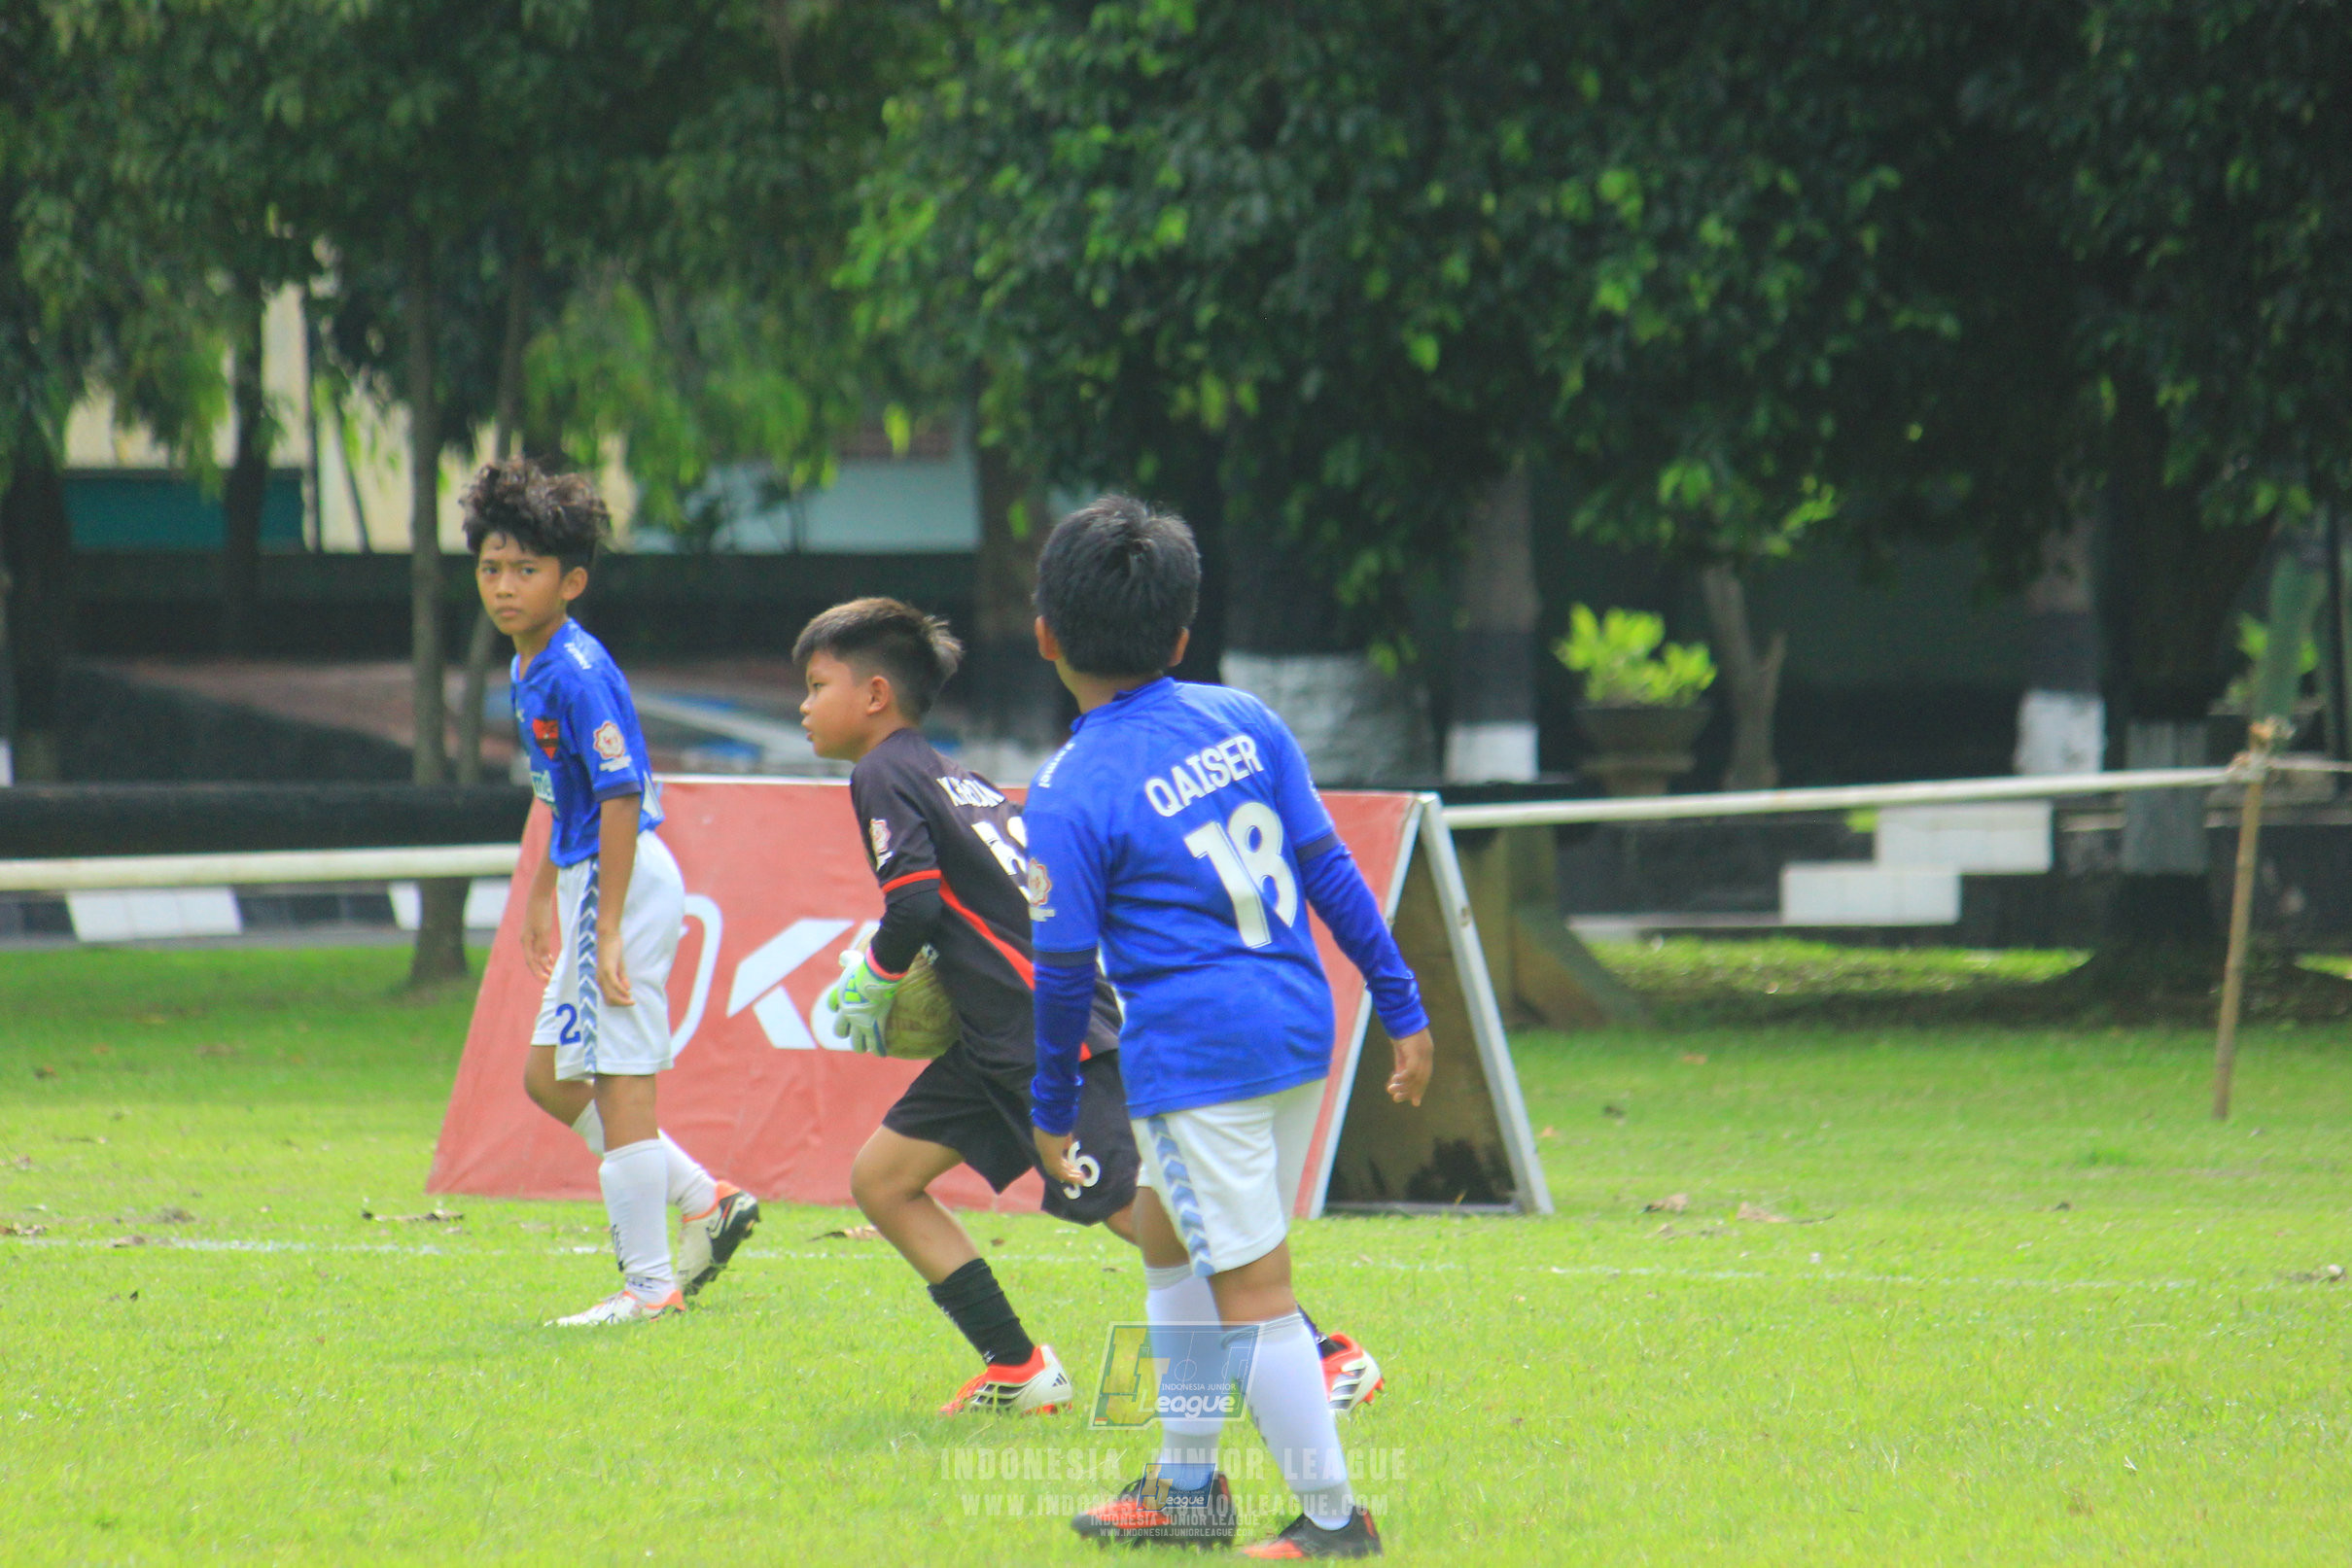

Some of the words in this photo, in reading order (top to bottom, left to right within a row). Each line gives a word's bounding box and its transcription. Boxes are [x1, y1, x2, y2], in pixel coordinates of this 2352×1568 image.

[1144, 735, 1264, 818] QAISER
[1183, 801, 1298, 949] 18
[555, 1003, 581, 1046] 2
